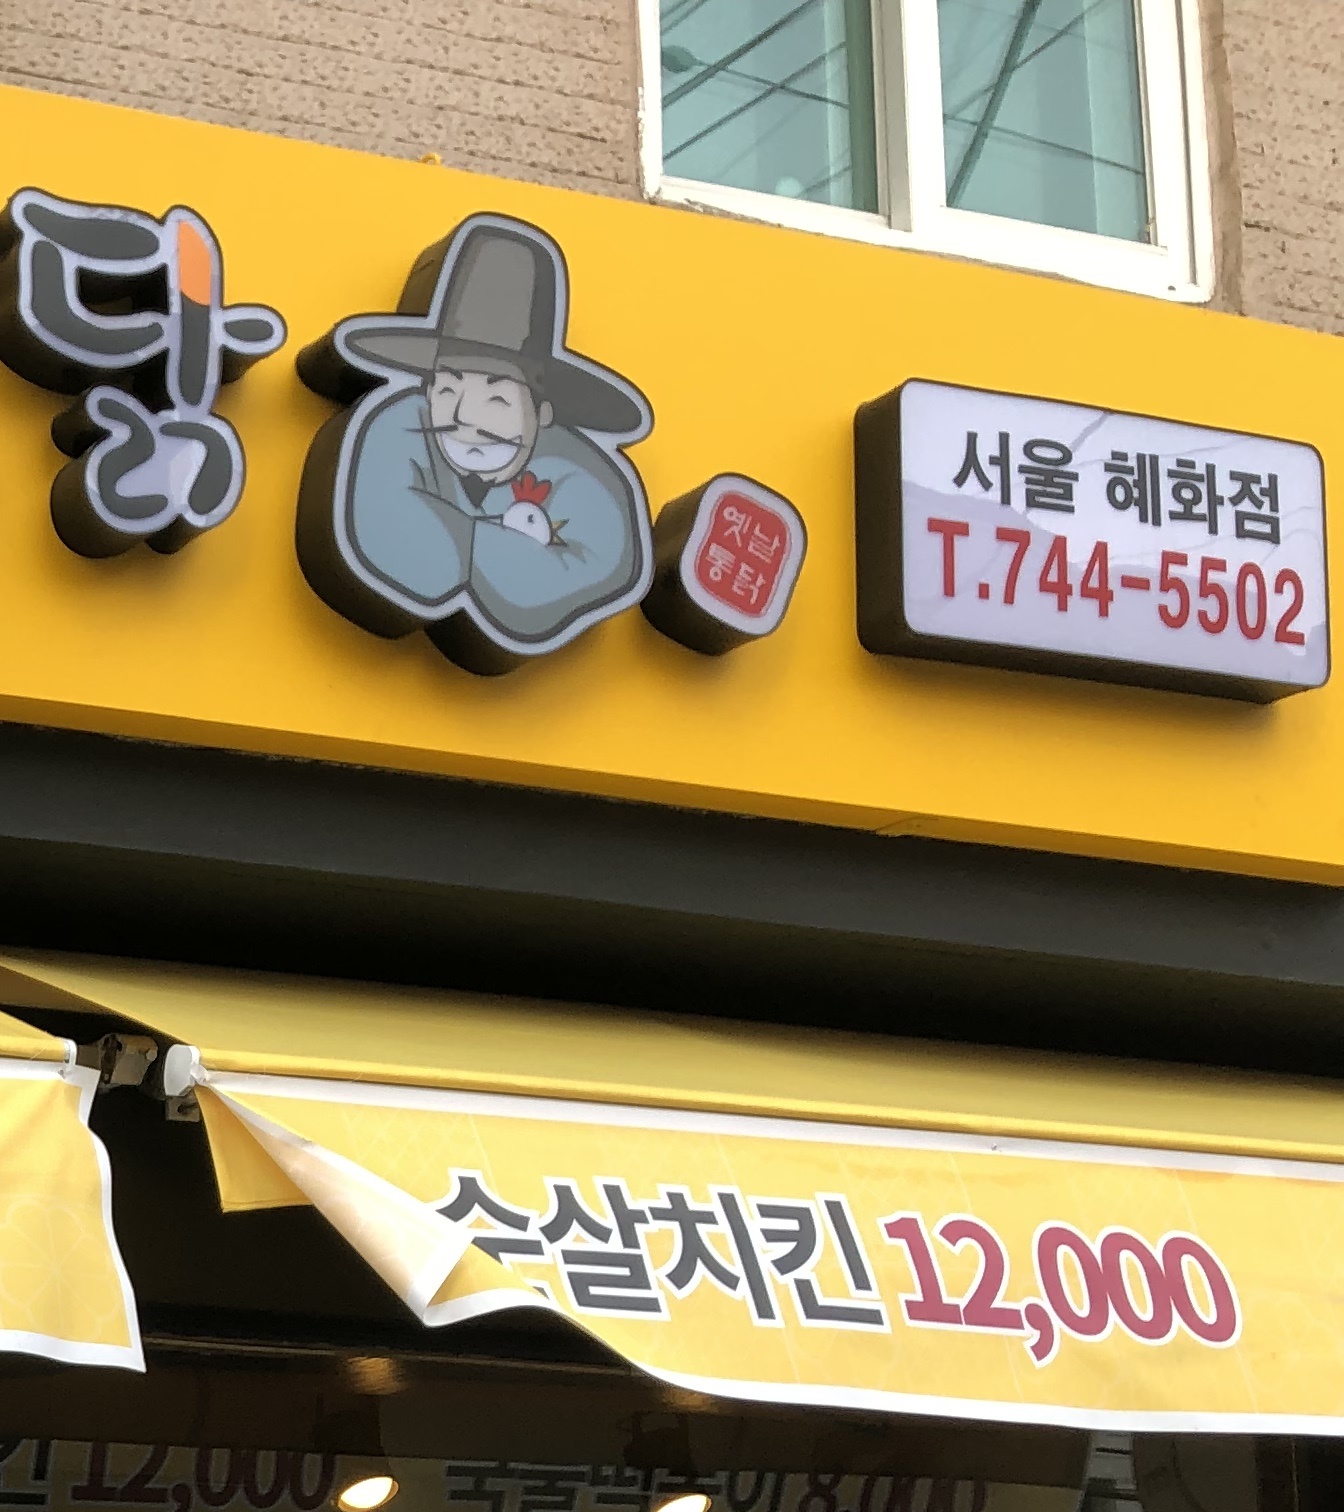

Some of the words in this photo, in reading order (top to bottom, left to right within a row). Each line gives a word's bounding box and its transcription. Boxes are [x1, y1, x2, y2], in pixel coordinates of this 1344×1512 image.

[952, 428, 1080, 513] 서울
[1104, 448, 1283, 548] 혜화점
[926, 517, 1308, 648] T.744-5502
[886, 1215, 1240, 1364] 12,000
